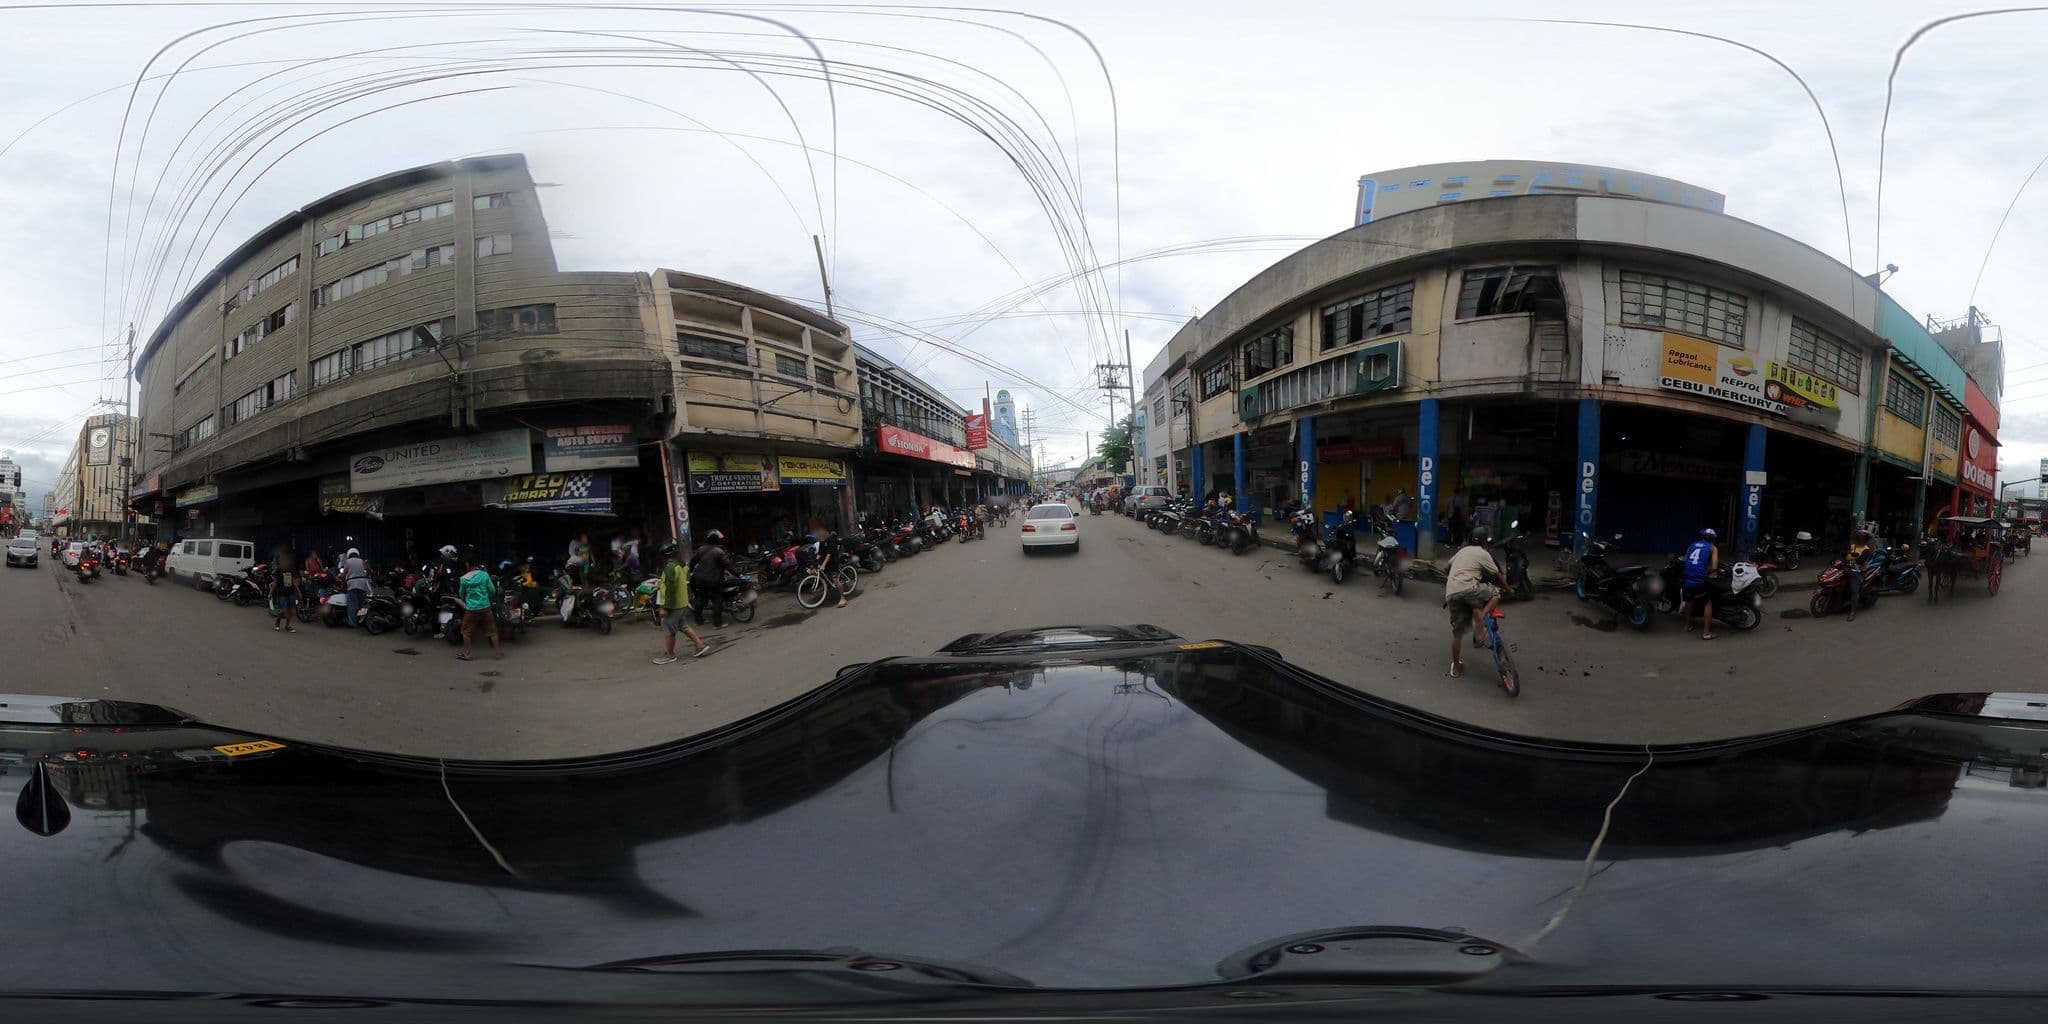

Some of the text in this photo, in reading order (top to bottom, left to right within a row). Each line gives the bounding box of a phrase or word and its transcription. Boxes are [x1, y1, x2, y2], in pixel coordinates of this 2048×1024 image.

[1668, 349, 1698, 361] Repsol
[1668, 357, 1712, 372] Lubricants
[1721, 376, 1761, 393] REPSOL
[1661, 377, 1704, 392] CEBU
[1708, 386, 1773, 409] MERCURY
[557, 436, 585, 447] AUTO
[587, 434, 624, 445] SUPPLY
[897, 439, 924, 453] HONDA
[384, 444, 440, 463] UNITED
[780, 461, 830, 470] YOKOHAMA
[1689, 548, 1701, 565] 4
